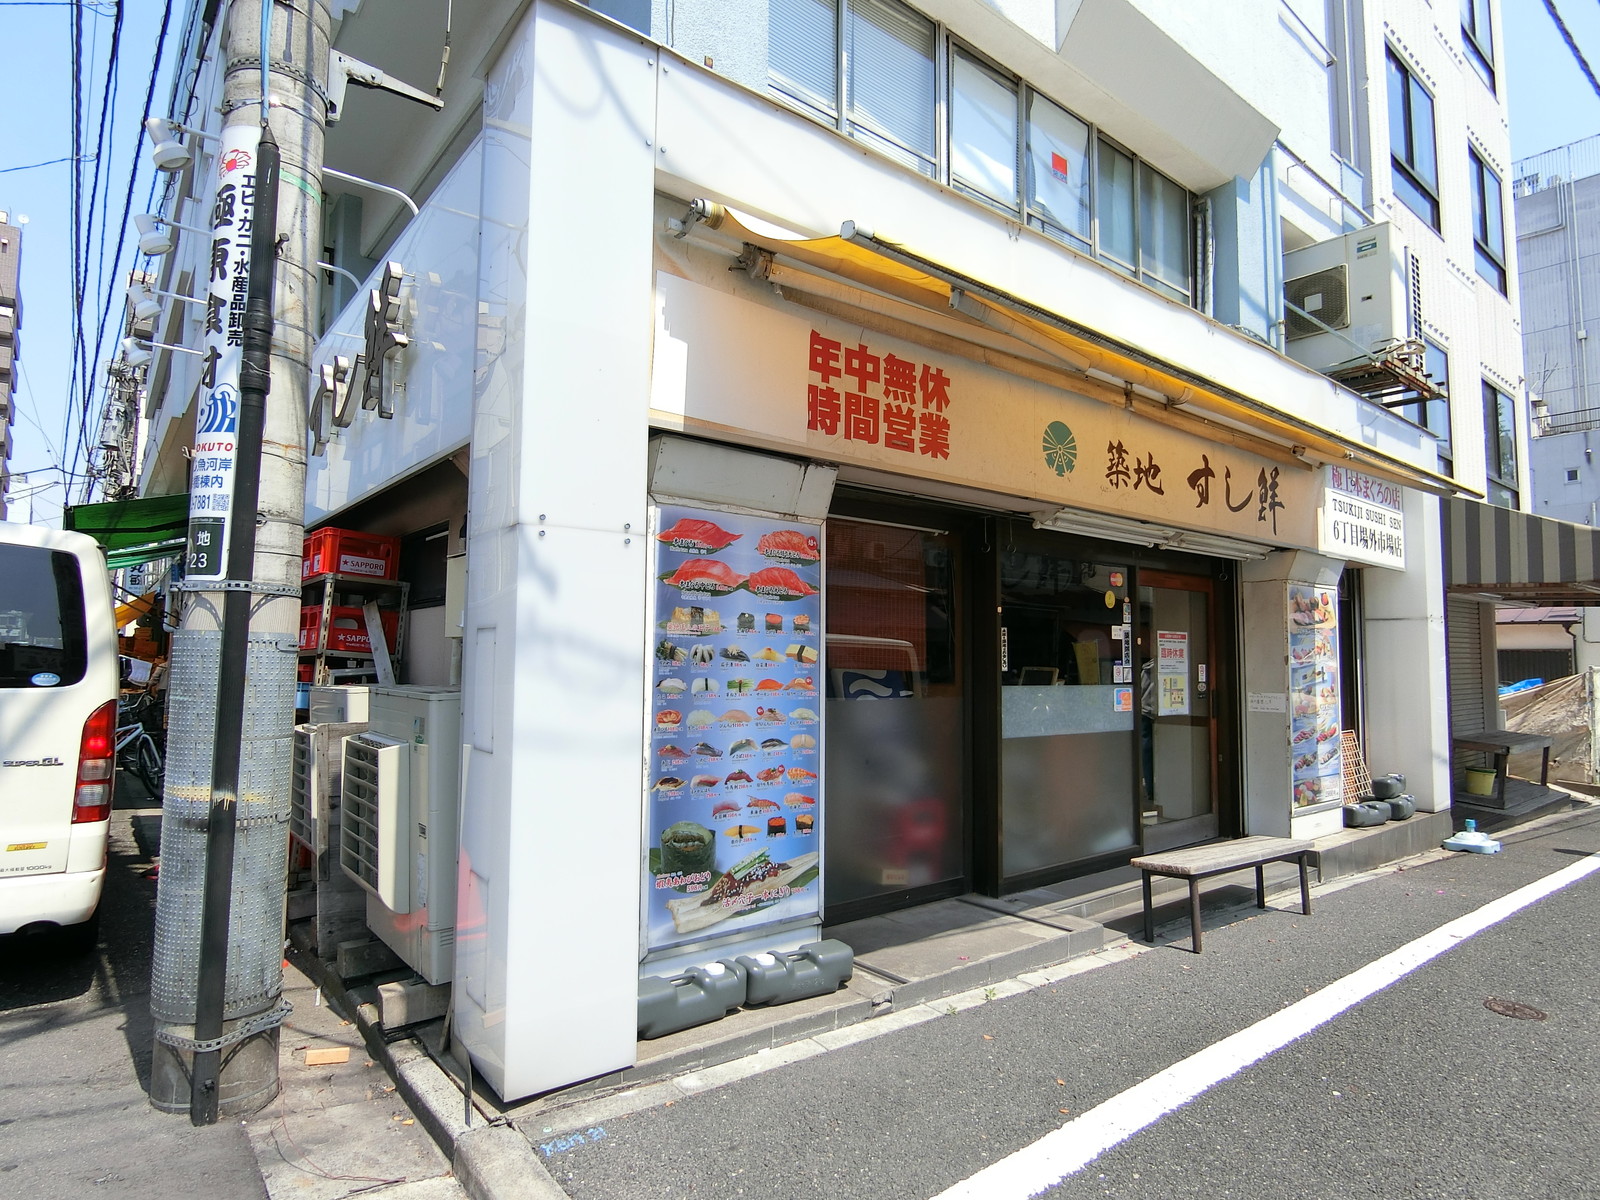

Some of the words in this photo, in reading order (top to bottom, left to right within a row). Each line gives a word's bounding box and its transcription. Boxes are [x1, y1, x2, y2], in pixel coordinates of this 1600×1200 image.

[809, 329, 951, 413] 年中無休
[807, 383, 951, 460] 時間営業
[1105, 439, 1165, 496] 築地
[1186, 454, 1286, 537] すし鮮
[1332, 498, 1363, 520] TSUKIJI
[1365, 508, 1387, 527] SUSHI
[1389, 516, 1402, 531] SEN
[350, 560, 384, 571] SAPPORO
